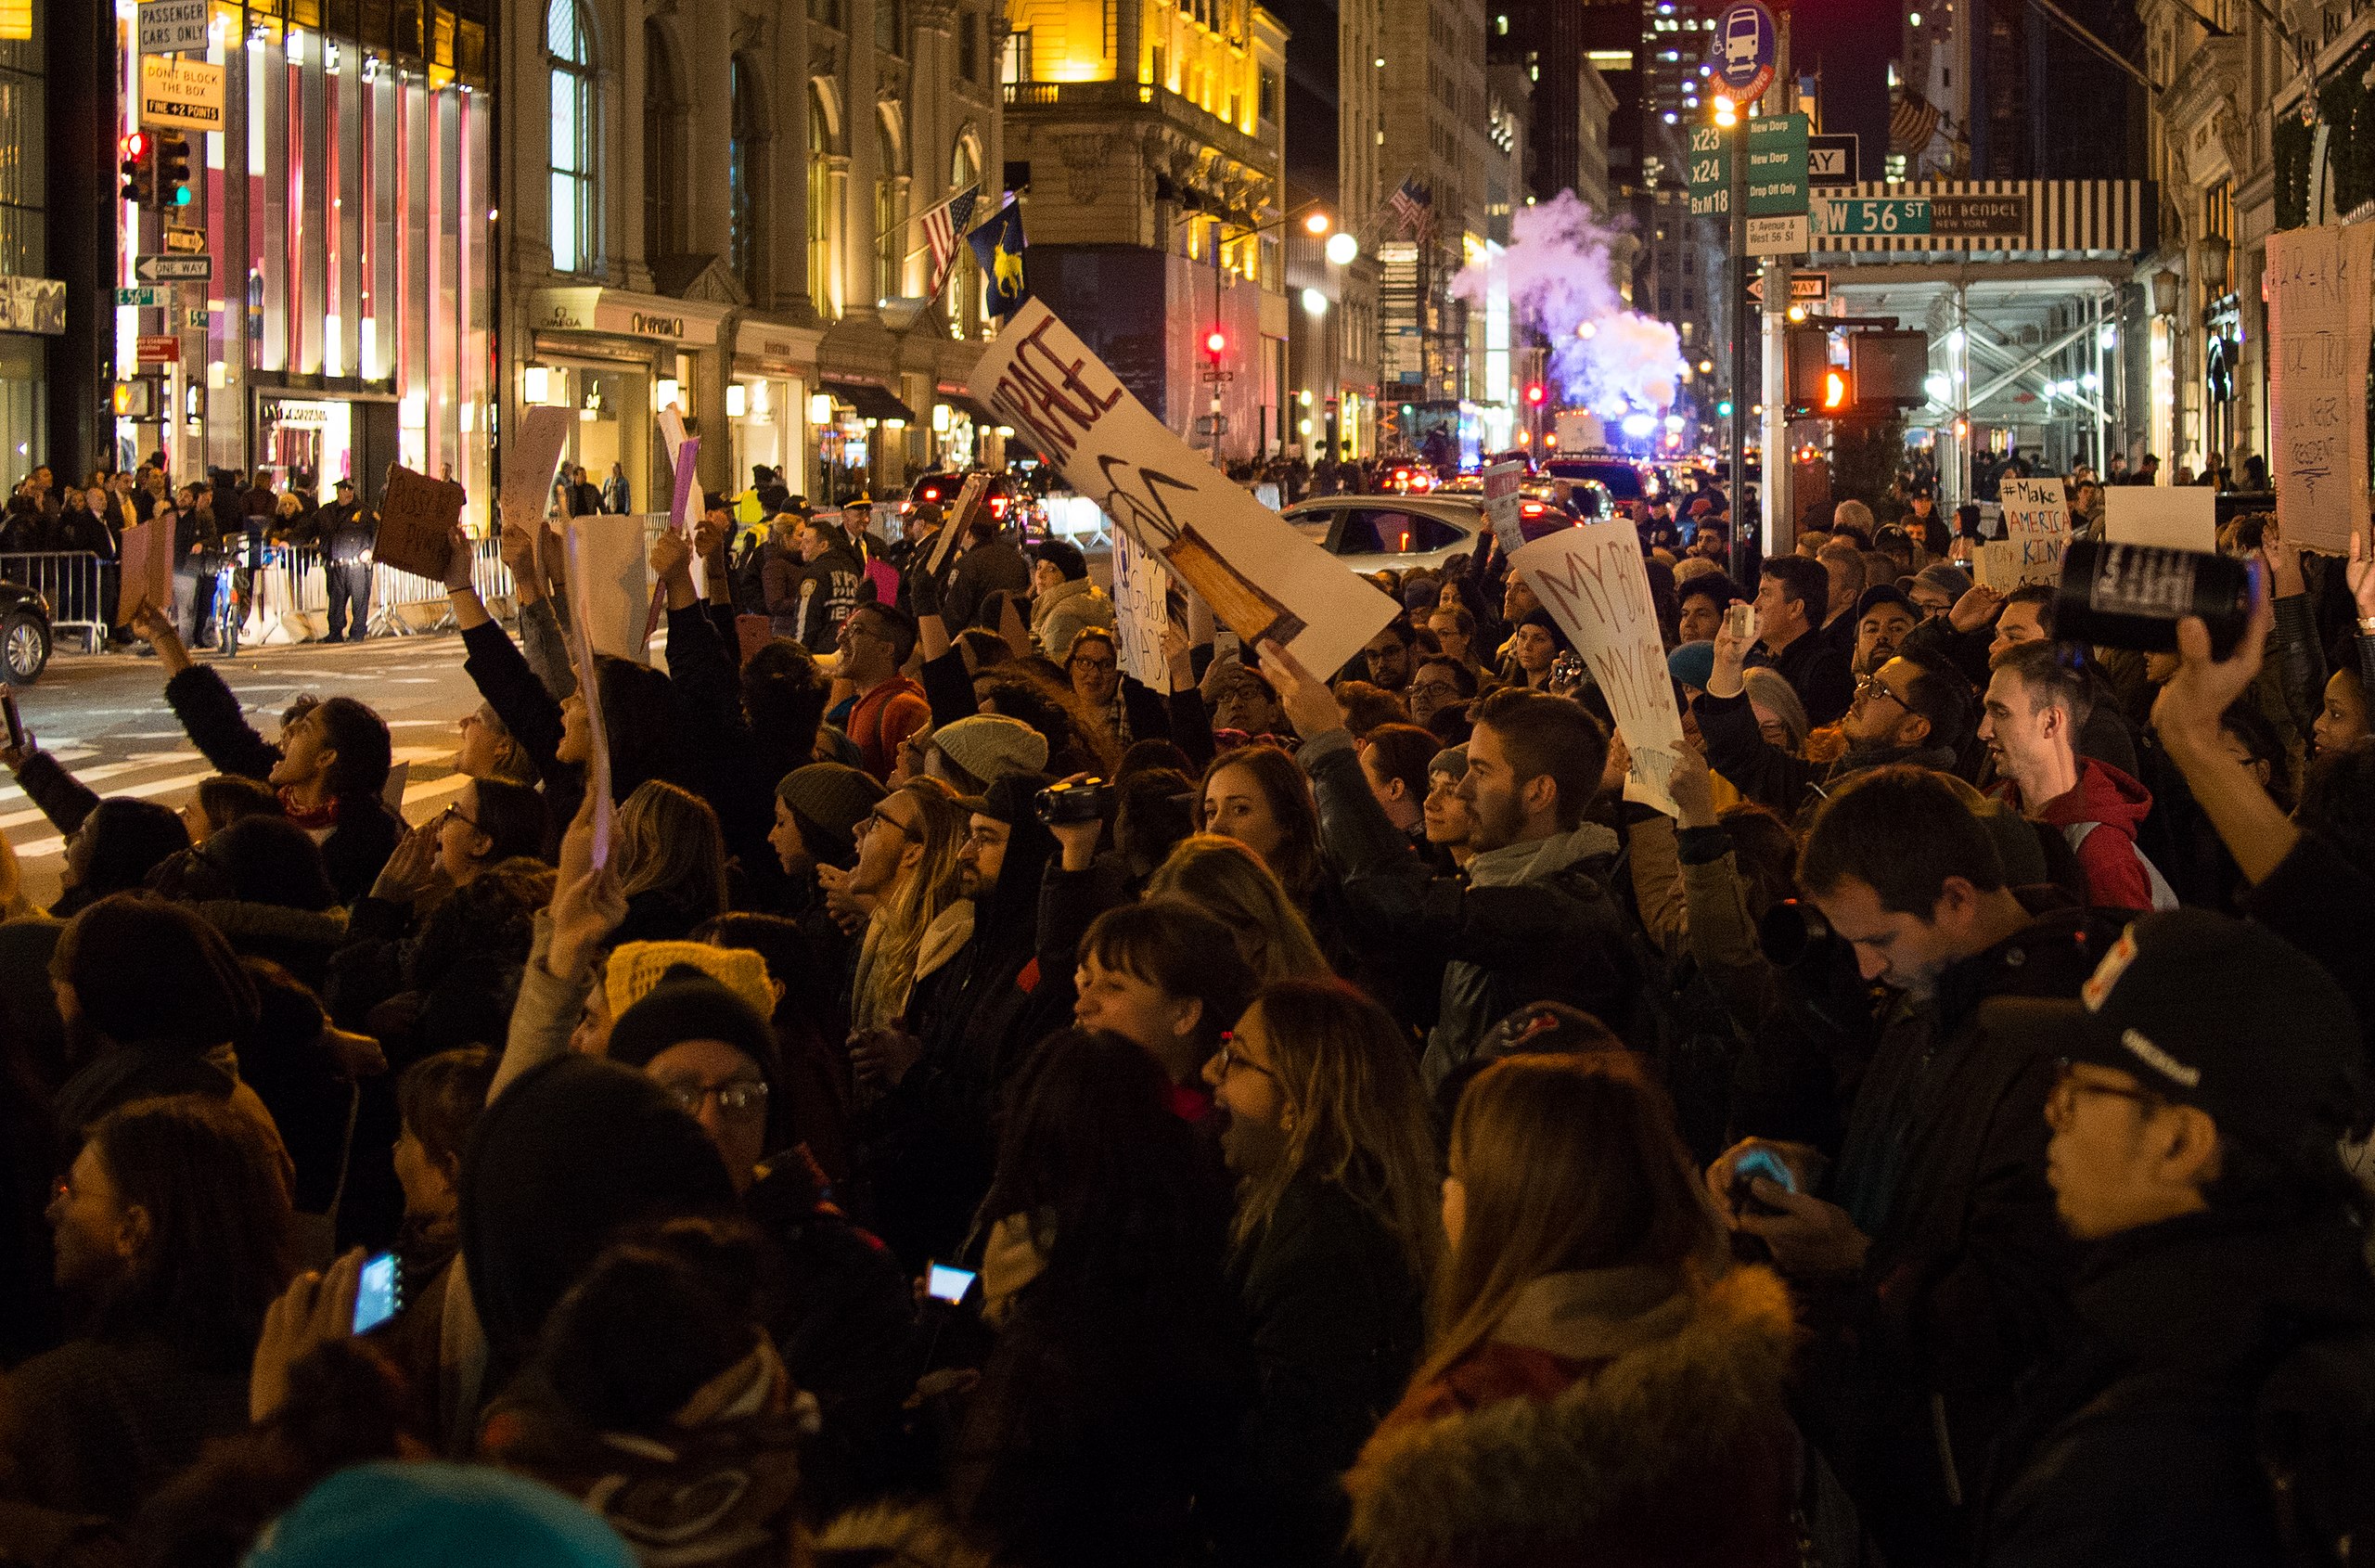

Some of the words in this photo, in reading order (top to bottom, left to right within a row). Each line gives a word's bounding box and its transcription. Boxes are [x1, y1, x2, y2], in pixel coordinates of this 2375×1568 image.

[142, 4, 203, 24] PASSENGER
[142, 28, 171, 45] CARS
[177, 24, 204, 42] ONLY
[184, 71, 218, 85] BLOCK
[161, 82, 182, 95] THE
[186, 84, 206, 96] BOX
[1751, 122, 1768, 134] New
[1769, 120, 1789, 132] Dorp
[1691, 127, 1720, 151] x23
[1751, 154, 1768, 165] New
[1769, 152, 1789, 164] Dorp
[1808, 152, 1834, 172] AY
[1691, 159, 1720, 183] x24
[1750, 186, 1767, 198] Drop
[1768, 184, 1779, 195] Off
[1780, 183, 1797, 196] Only
[1691, 189, 1728, 214] BxM18
[1750, 222, 1755, 232] 5
[1759, 221, 1785, 232] Avenue
[1789, 219, 1795, 229] &
[1827, 202, 1848, 232] W
[1862, 202, 1898, 231] 56
[1905, 202, 1925, 218] ST
[1935, 219, 1958, 228] NEW
[1962, 219, 1988, 228] YORK
[1750, 233, 1769, 243] West
[1772, 232, 1782, 242] 56
[1785, 231, 1794, 241] St
[156, 263, 174, 276] ONE
[182, 263, 203, 274] WAY
[1791, 282, 1817, 293] WAY
[118, 289, 124, 304] E
[127, 289, 141, 304] 56
[2003, 481, 2058, 504] #Make
[2009, 510, 2073, 534] AMERICA
[1534, 544, 1621, 634] MY
[1595, 645, 1642, 722] MY
